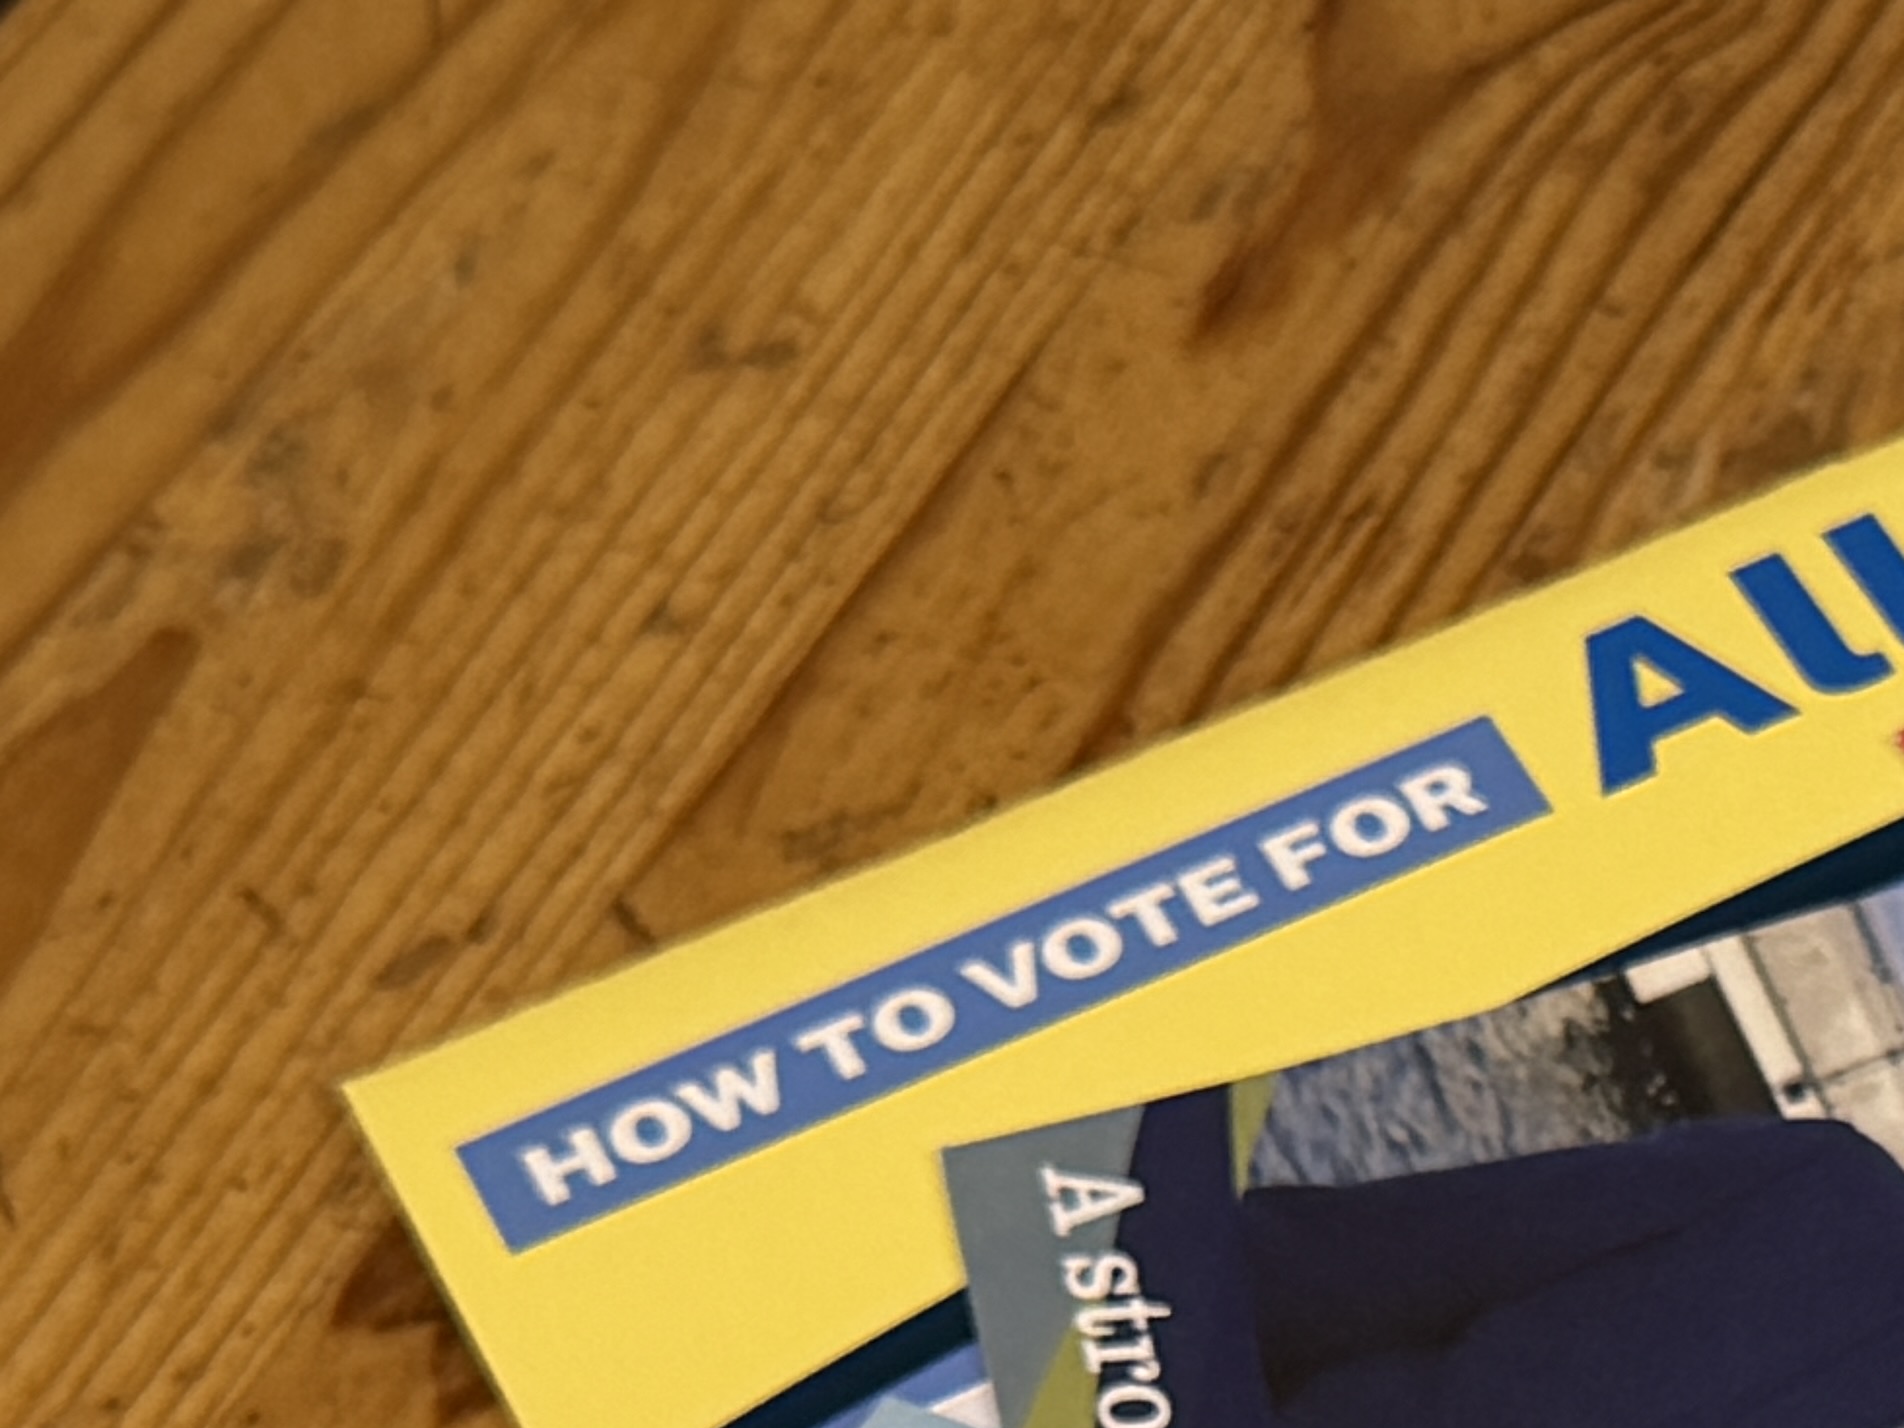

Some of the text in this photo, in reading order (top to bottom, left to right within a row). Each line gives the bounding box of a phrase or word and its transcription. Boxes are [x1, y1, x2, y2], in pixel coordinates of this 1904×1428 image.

[520, 760, 1490, 1205] HOW TO VOTE FOR
[1040, 1161, 1146, 1238] A
